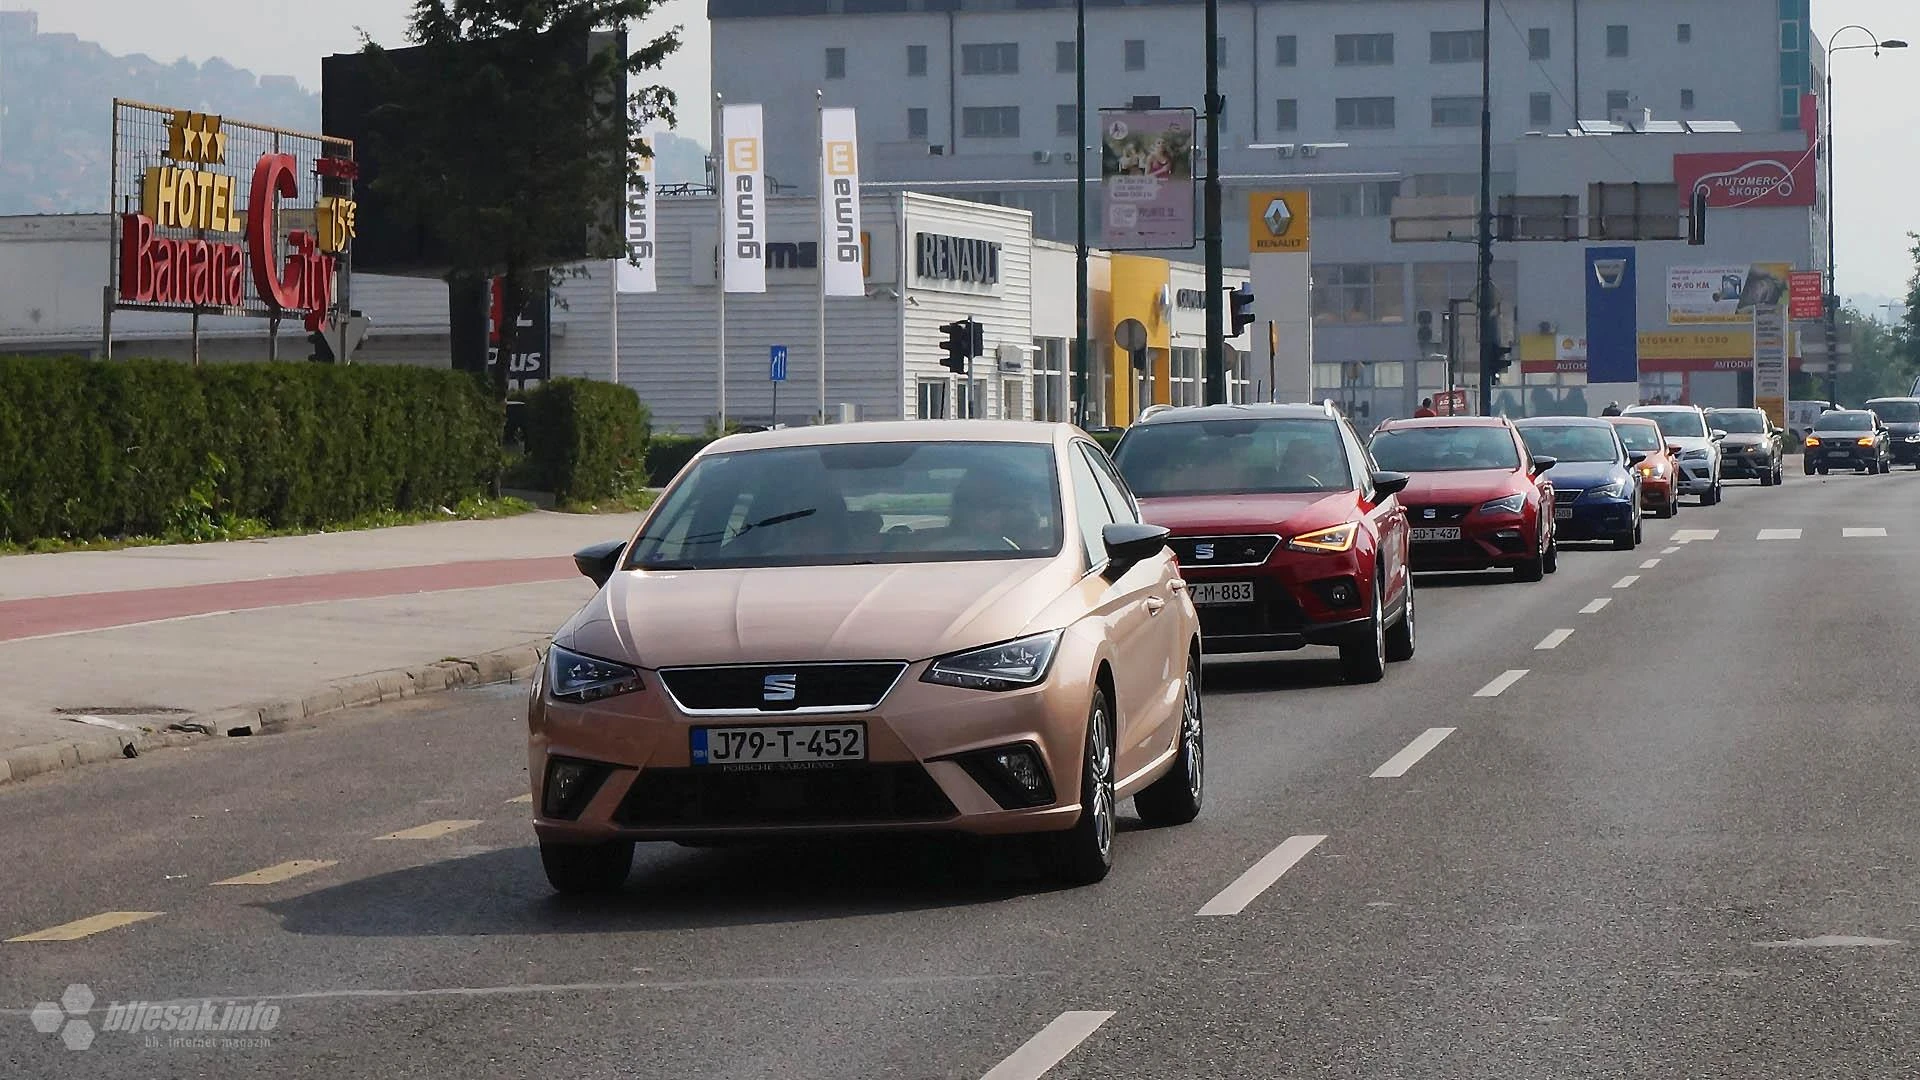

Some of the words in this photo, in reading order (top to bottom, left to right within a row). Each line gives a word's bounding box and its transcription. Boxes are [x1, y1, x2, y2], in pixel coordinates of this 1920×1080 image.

[1716, 176, 1779, 187] AUTOMERC
[157, 167, 241, 233] HOTEL
[918, 232, 1002, 284] RENAULT
[1257, 239, 1301, 248] RENAULT
[137, 214, 244, 306] Banana
[1188, 584, 1251, 601] 7-M-883
[713, 728, 860, 760] J79-T-452
